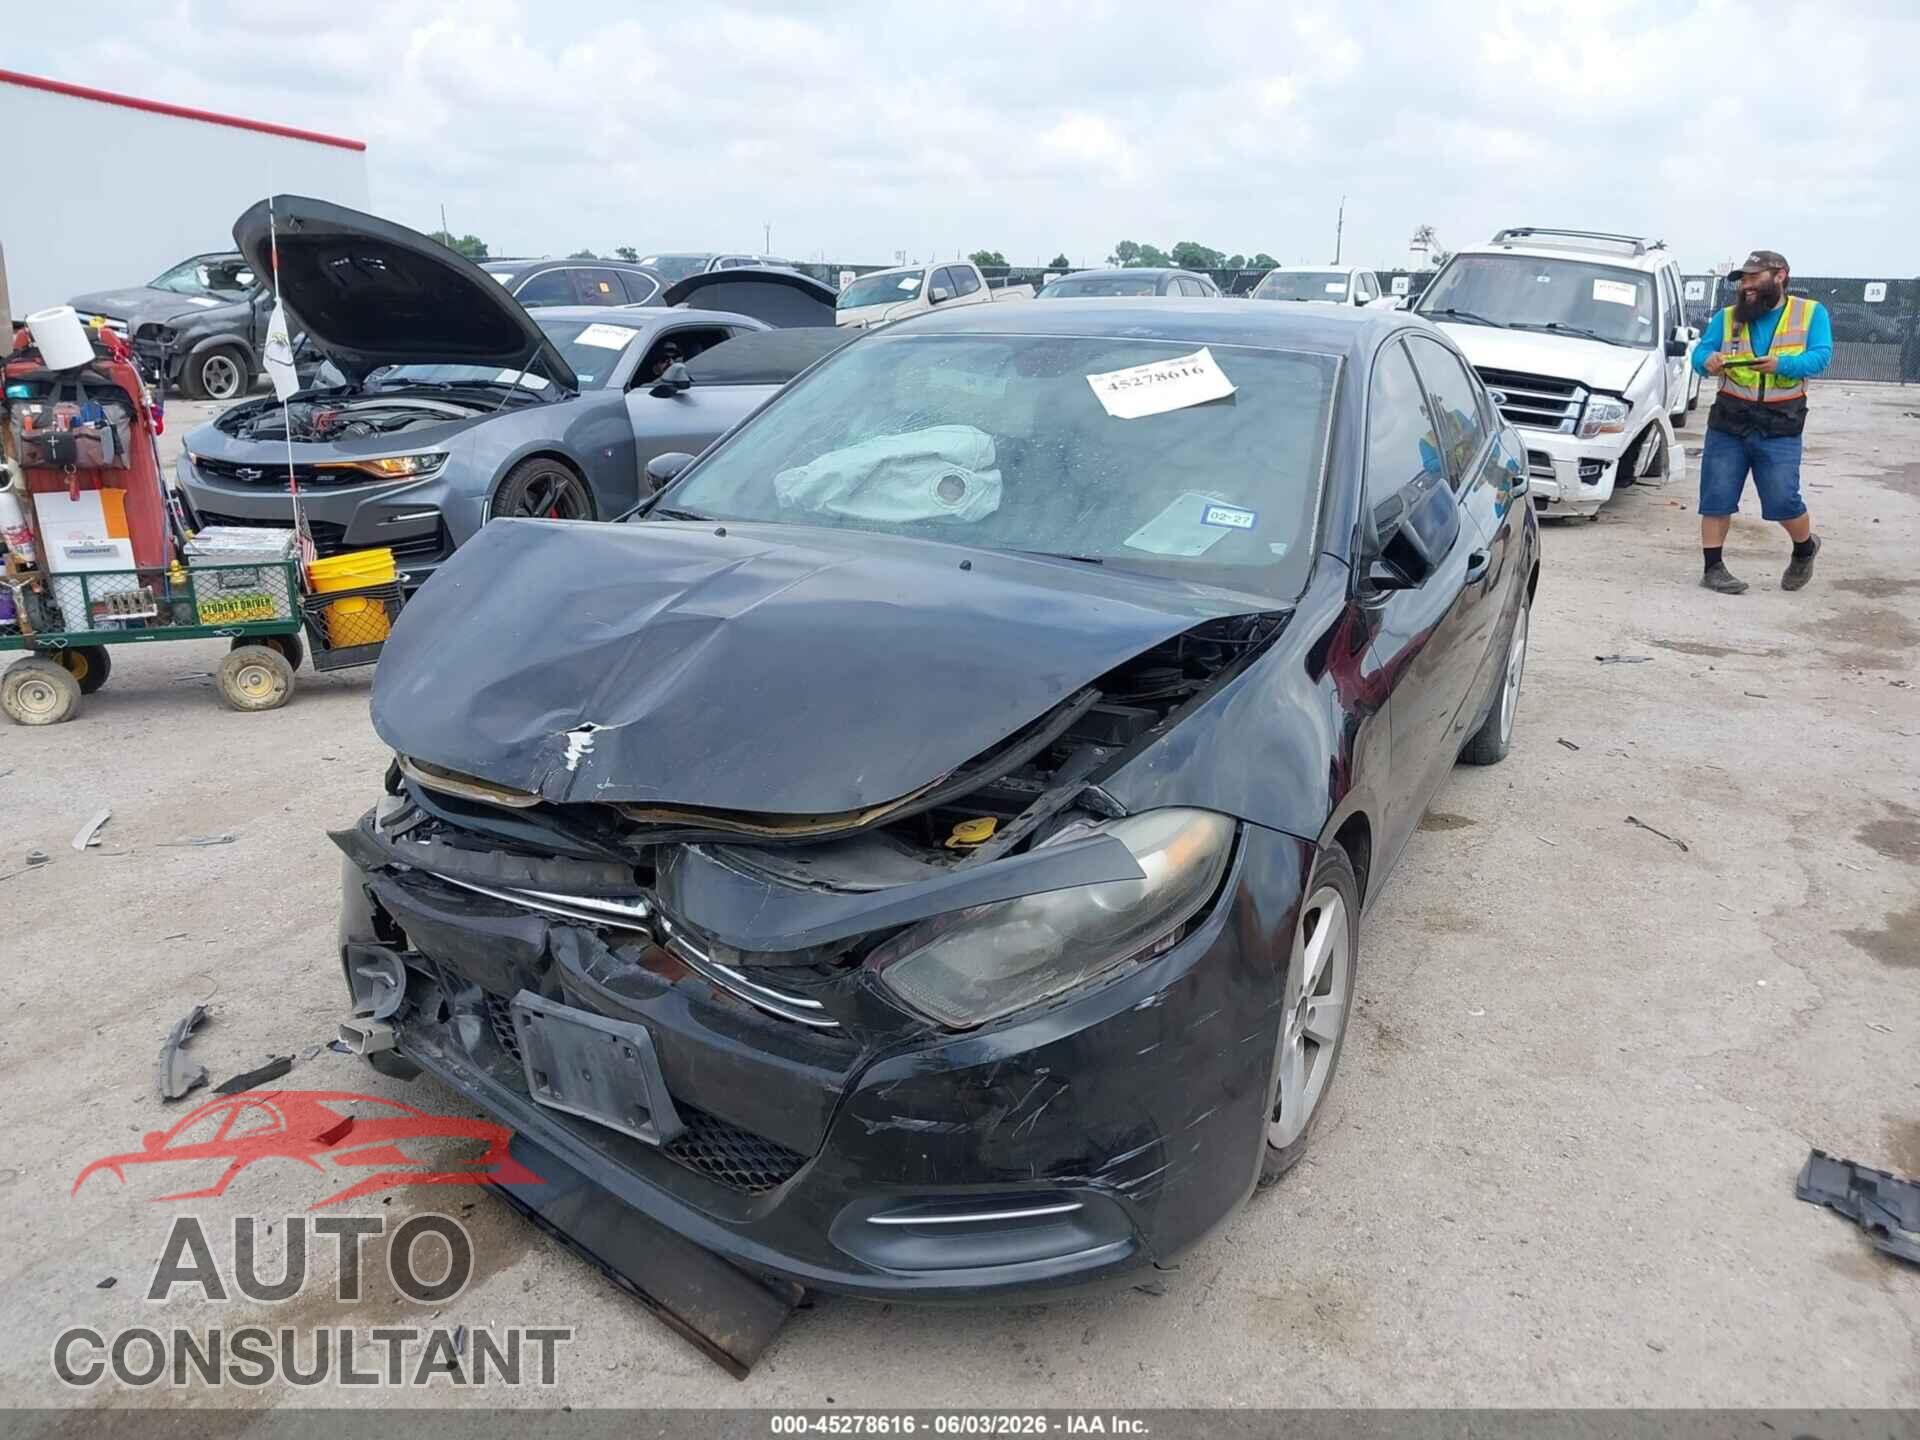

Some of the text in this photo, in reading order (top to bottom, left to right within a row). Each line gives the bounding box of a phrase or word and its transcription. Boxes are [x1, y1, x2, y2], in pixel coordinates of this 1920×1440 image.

[1107, 365, 1205, 391] 45278616
[1210, 510, 1251, 525] 02-27
[200, 598, 272, 614] STUDENT DRIVER
